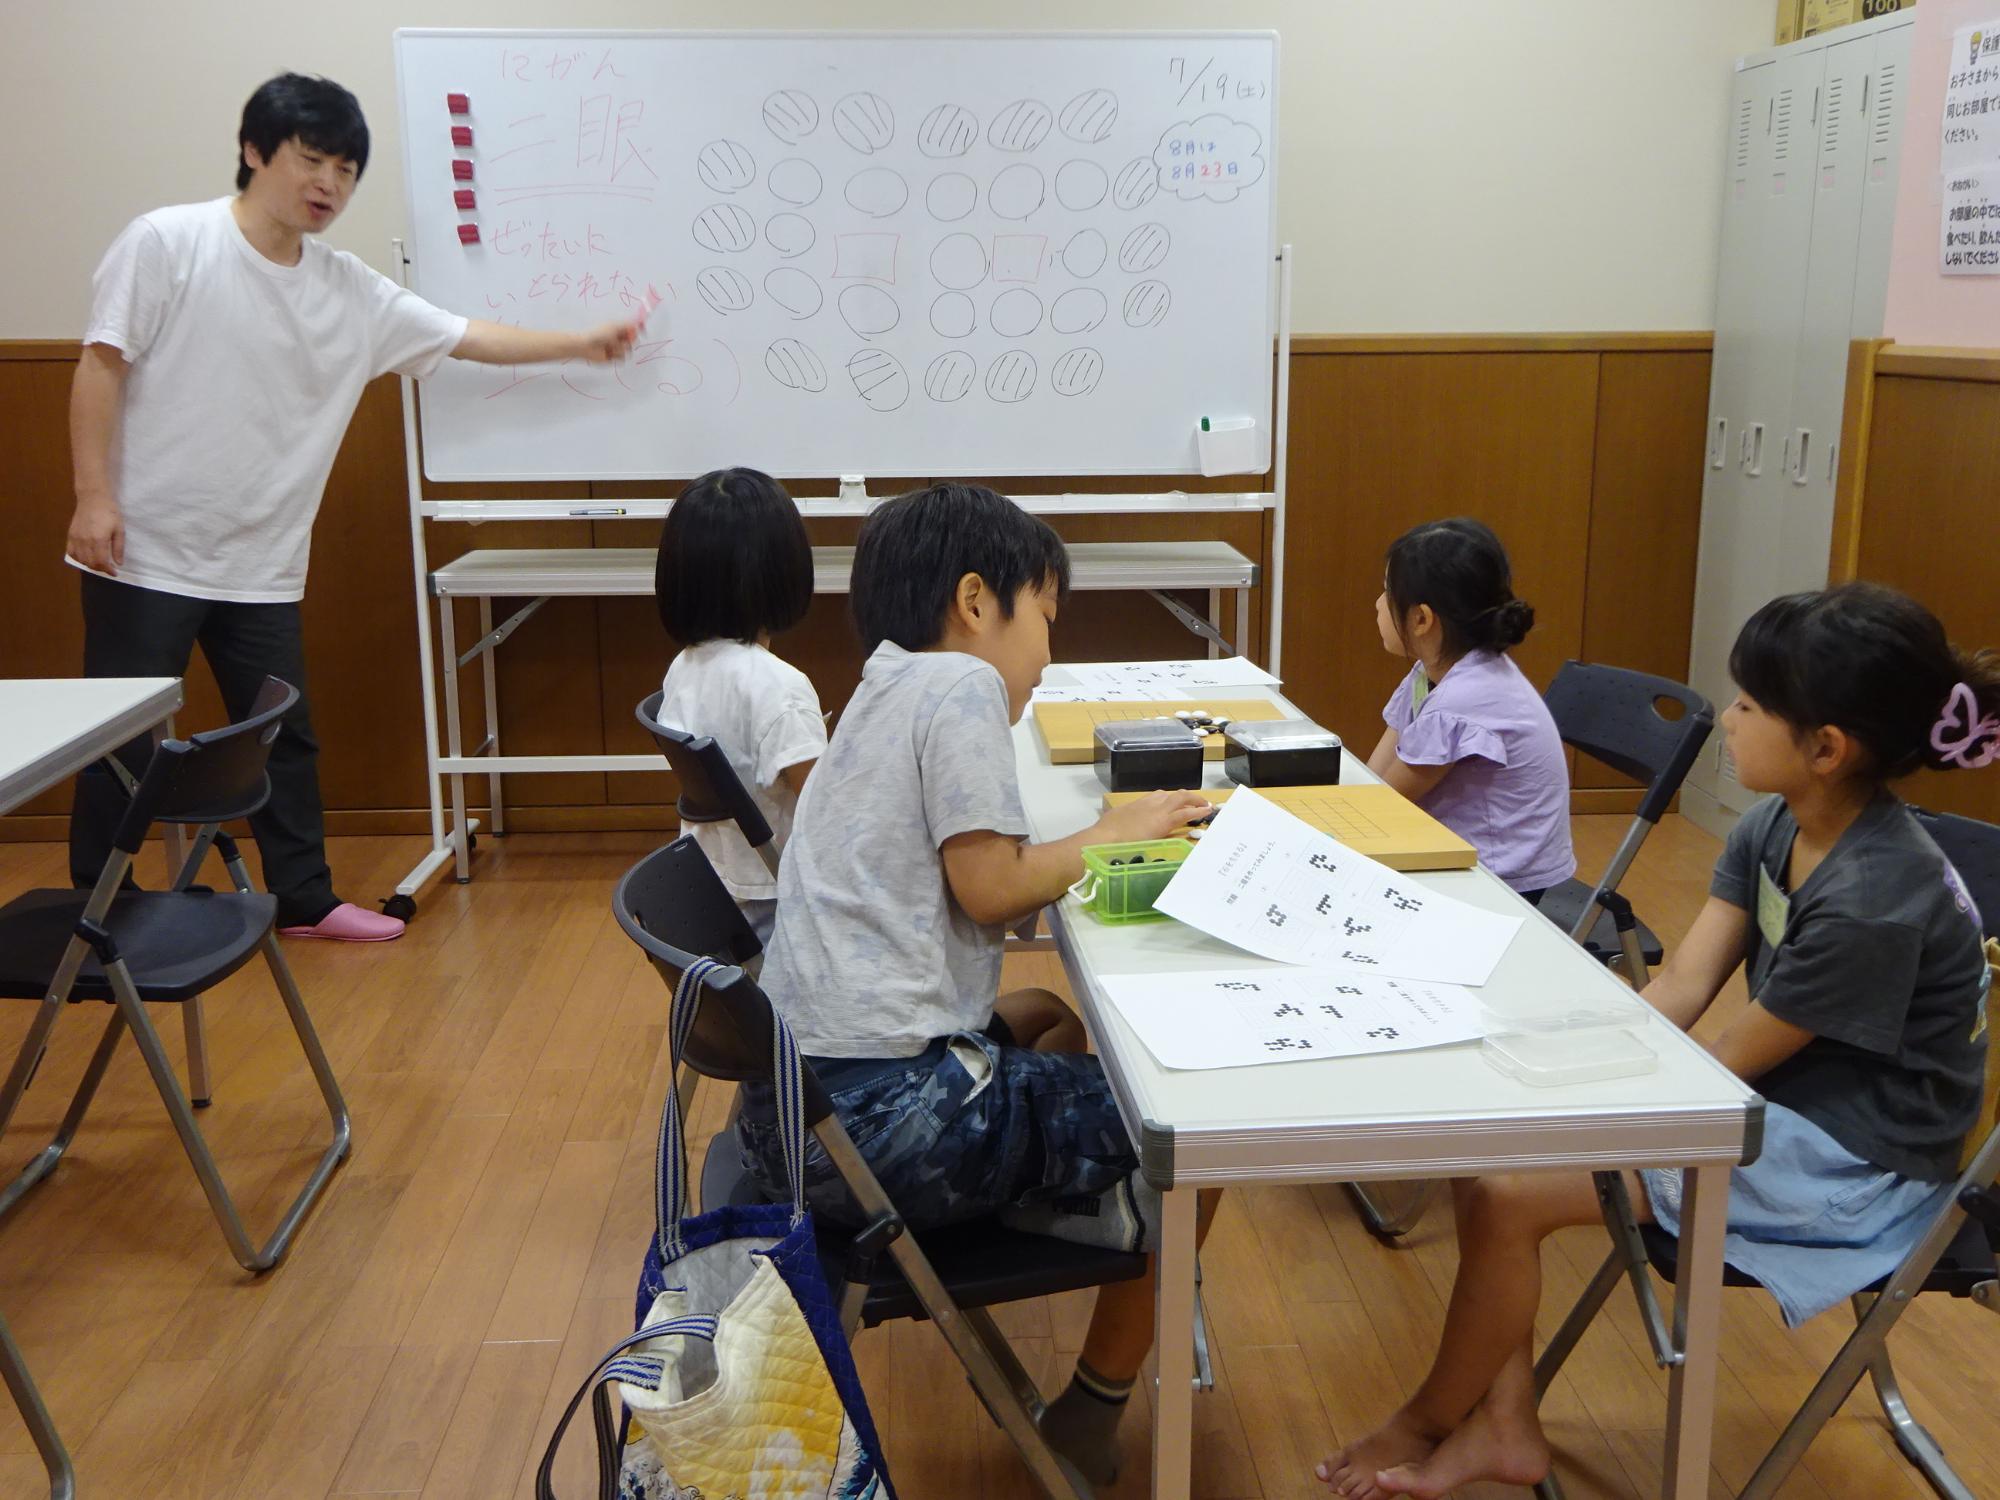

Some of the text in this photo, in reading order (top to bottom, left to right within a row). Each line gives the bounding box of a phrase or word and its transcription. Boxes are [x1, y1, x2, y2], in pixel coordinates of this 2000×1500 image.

[1866, 0, 1898, 13] 100
[502, 47, 625, 82] にがん
[1946, 95, 2000, 119] 同じお部屋で
[488, 93, 660, 183] 二眼
[1171, 160, 1239, 181] 8月23日
[489, 220, 613, 258] ぜったいに
